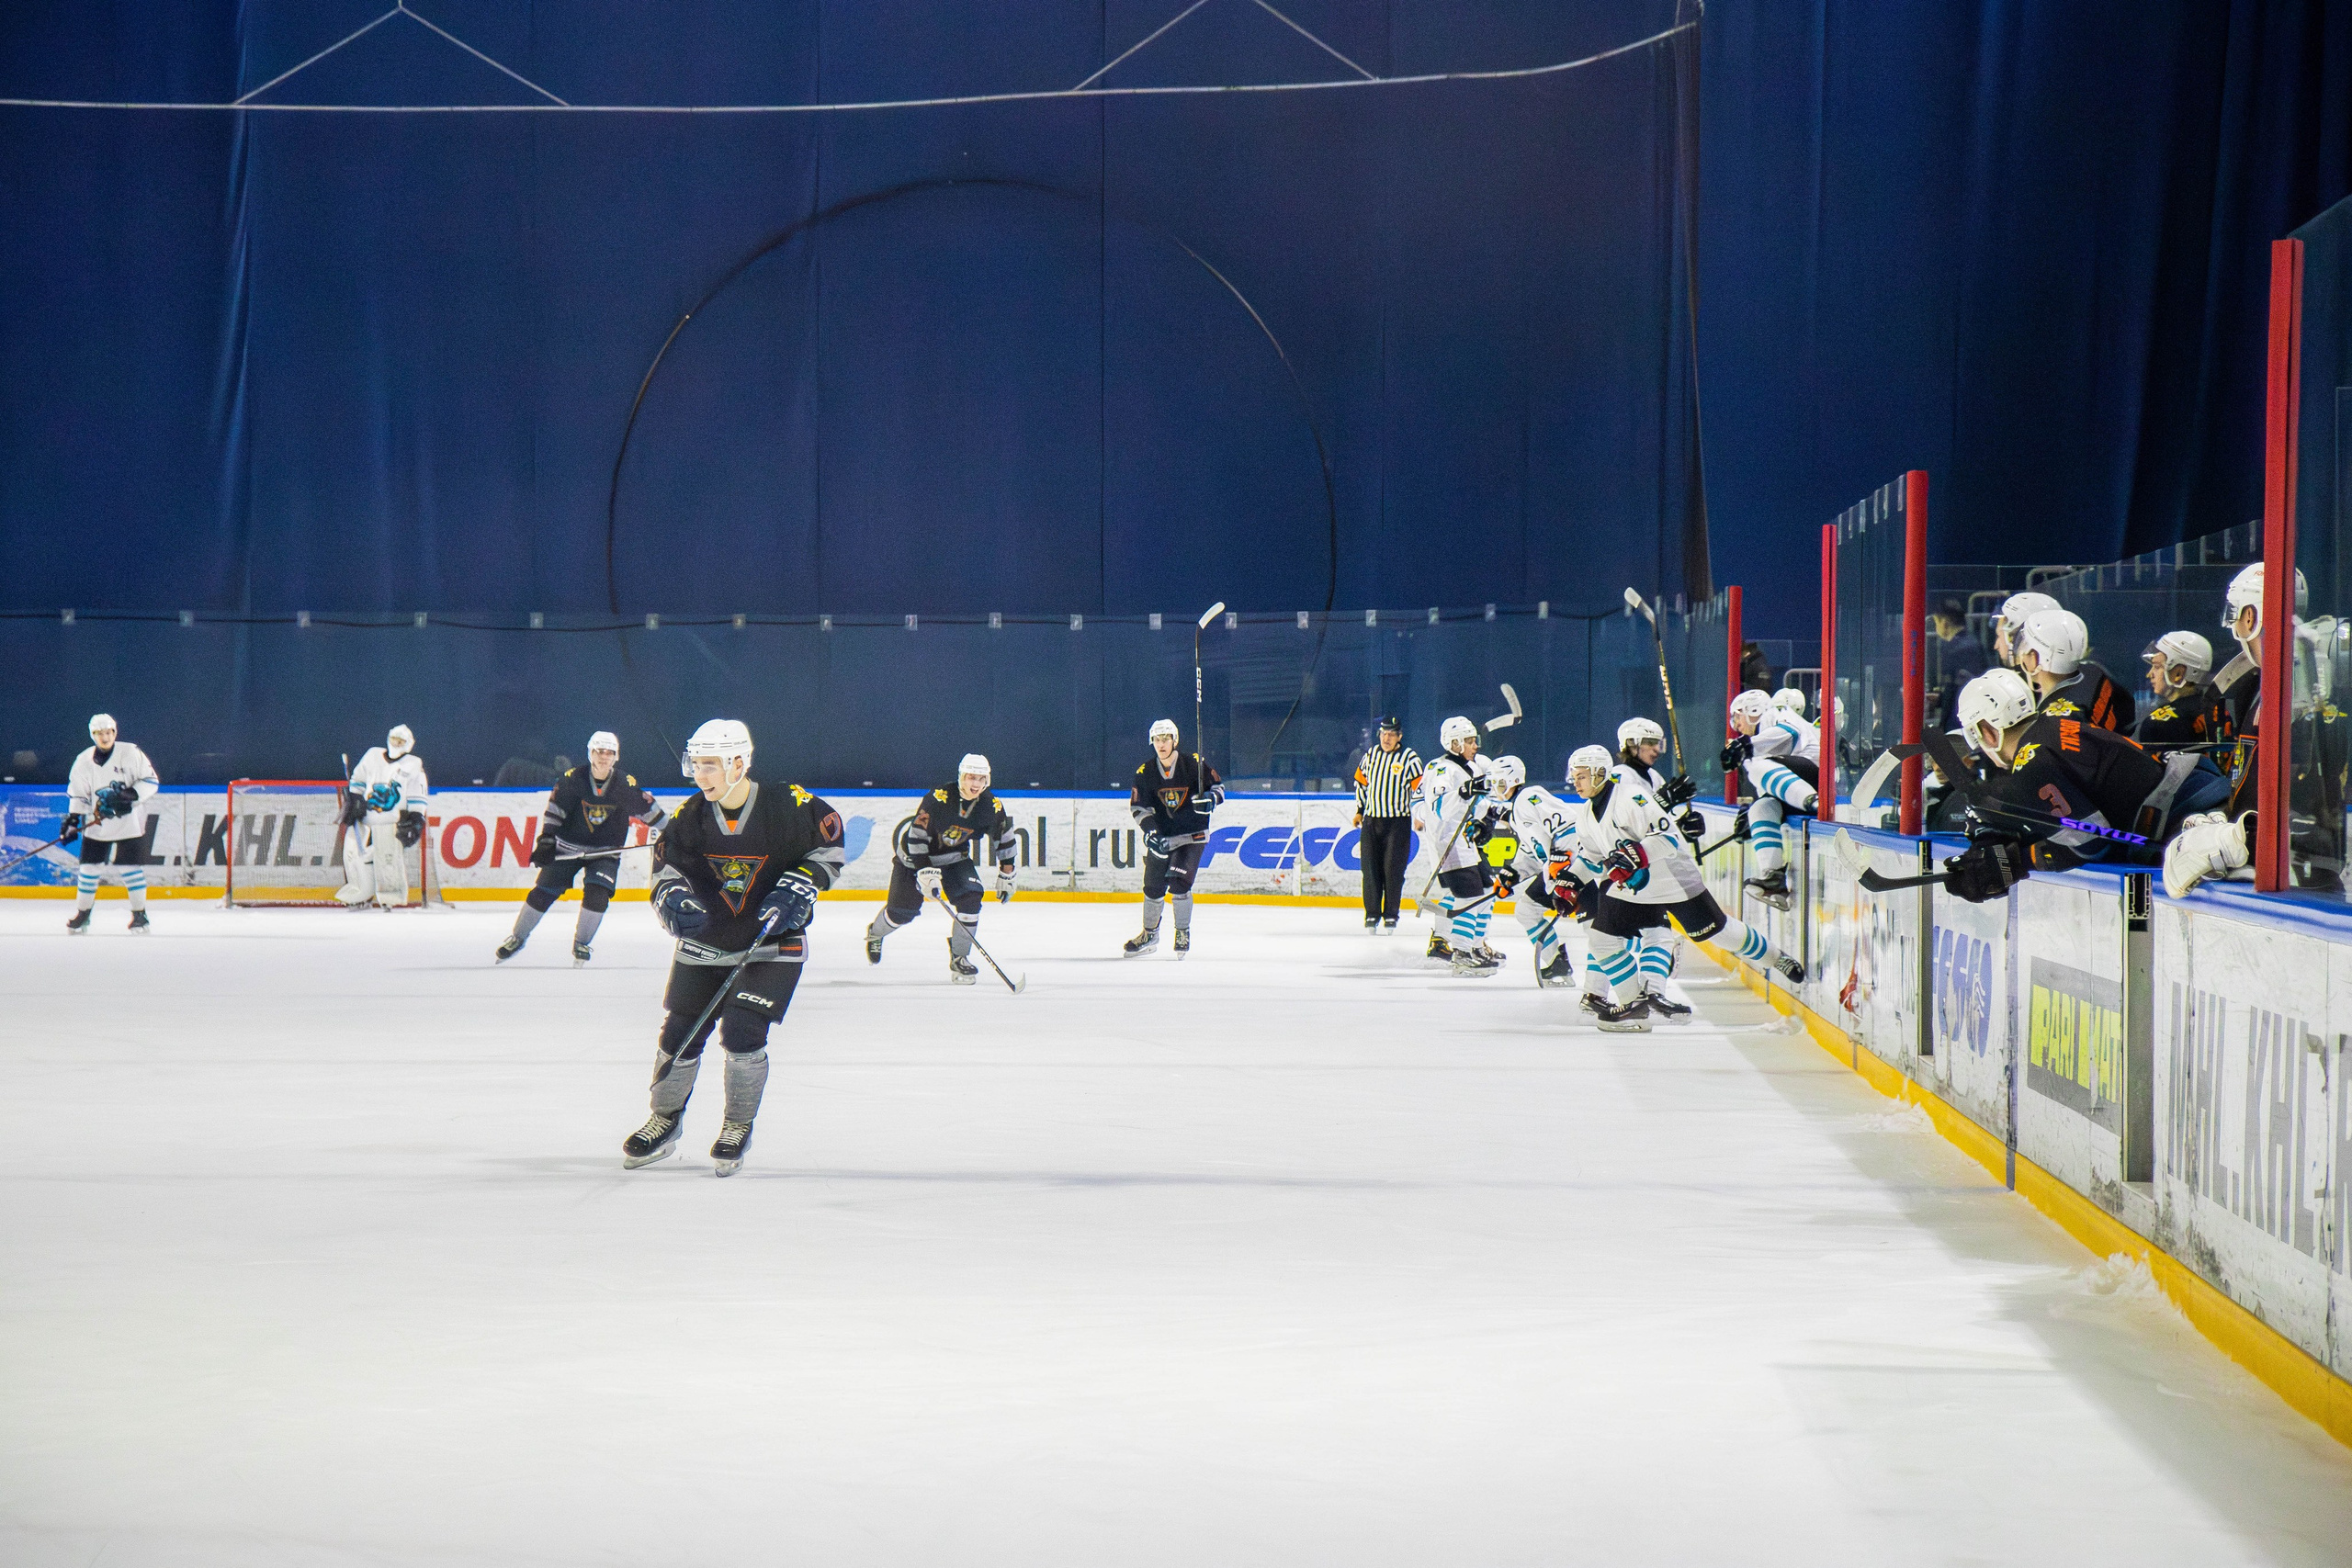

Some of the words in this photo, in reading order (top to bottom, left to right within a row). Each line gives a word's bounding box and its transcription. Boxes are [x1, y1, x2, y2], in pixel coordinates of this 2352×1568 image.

[1543, 812, 1567, 834] 22
[2060, 817, 2149, 846] SOYUZ
[1198, 826, 1420, 870] FESC
[776, 878, 818, 905] CCM
[737, 992, 775, 1009] CCM
